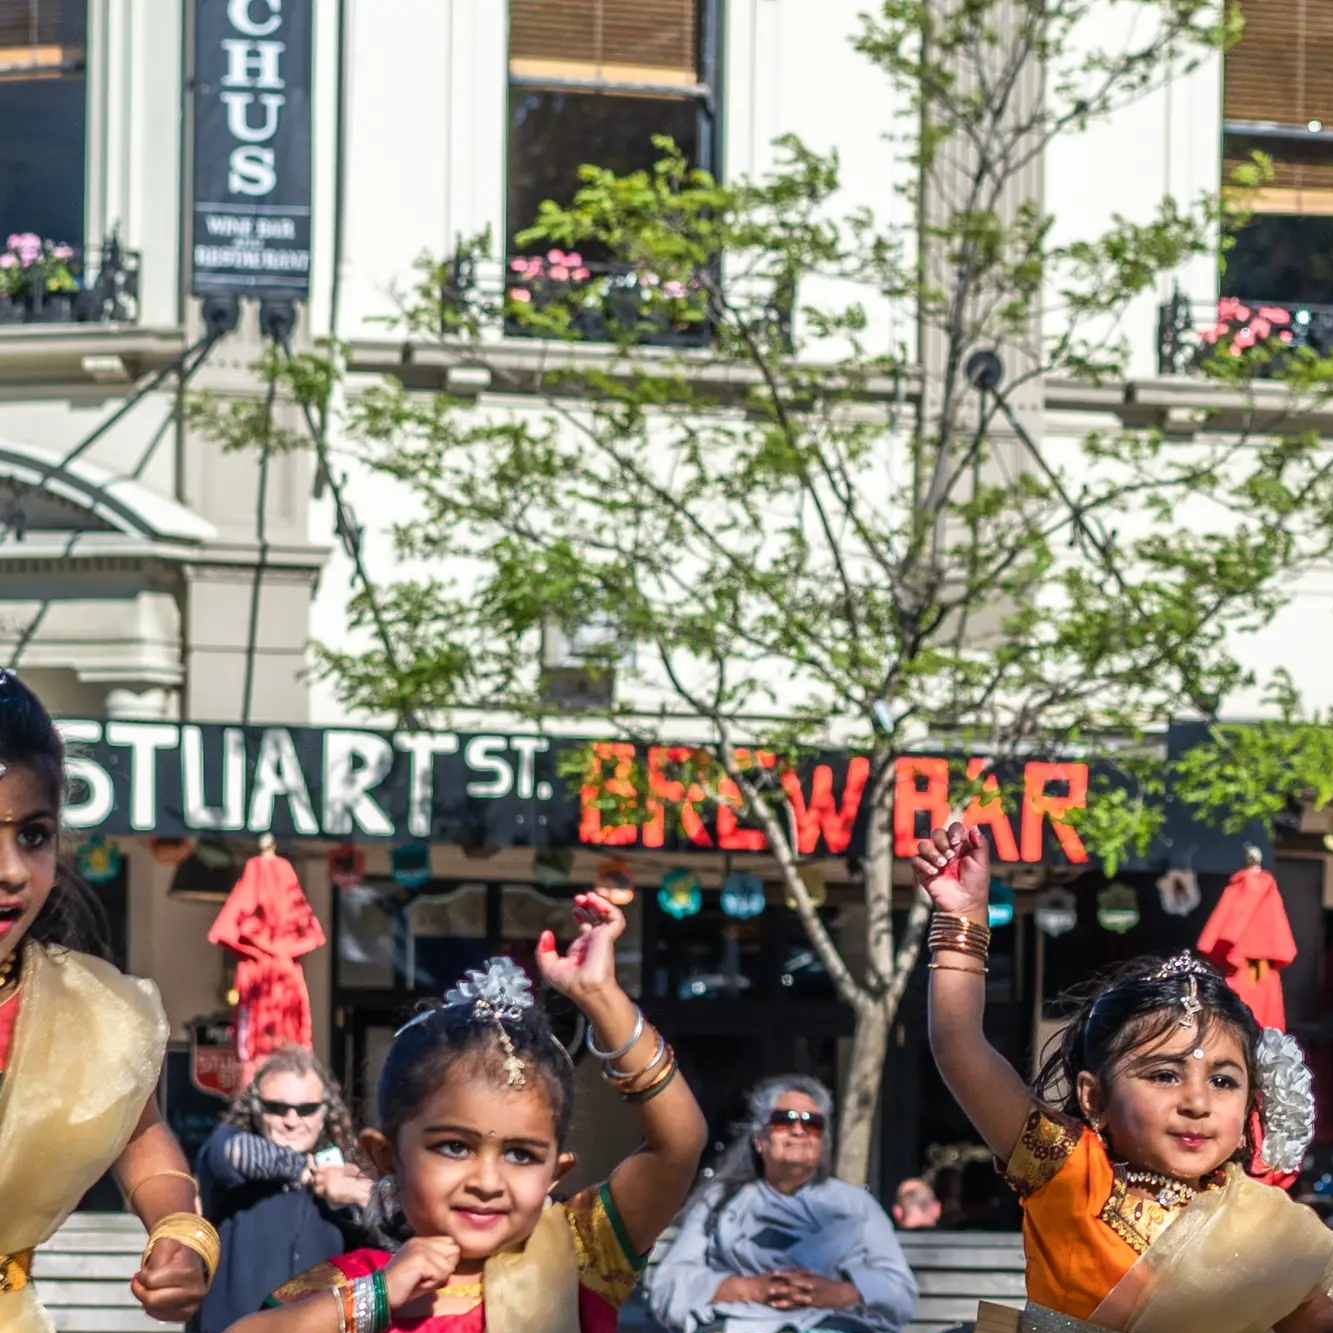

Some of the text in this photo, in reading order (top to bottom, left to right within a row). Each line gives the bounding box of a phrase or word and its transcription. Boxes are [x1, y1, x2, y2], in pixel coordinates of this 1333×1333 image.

[205, 213, 297, 240] WINE BAR
[194, 244, 310, 272] RESTAURANT
[54, 720, 1090, 864] STUART ST. BREW BAR
